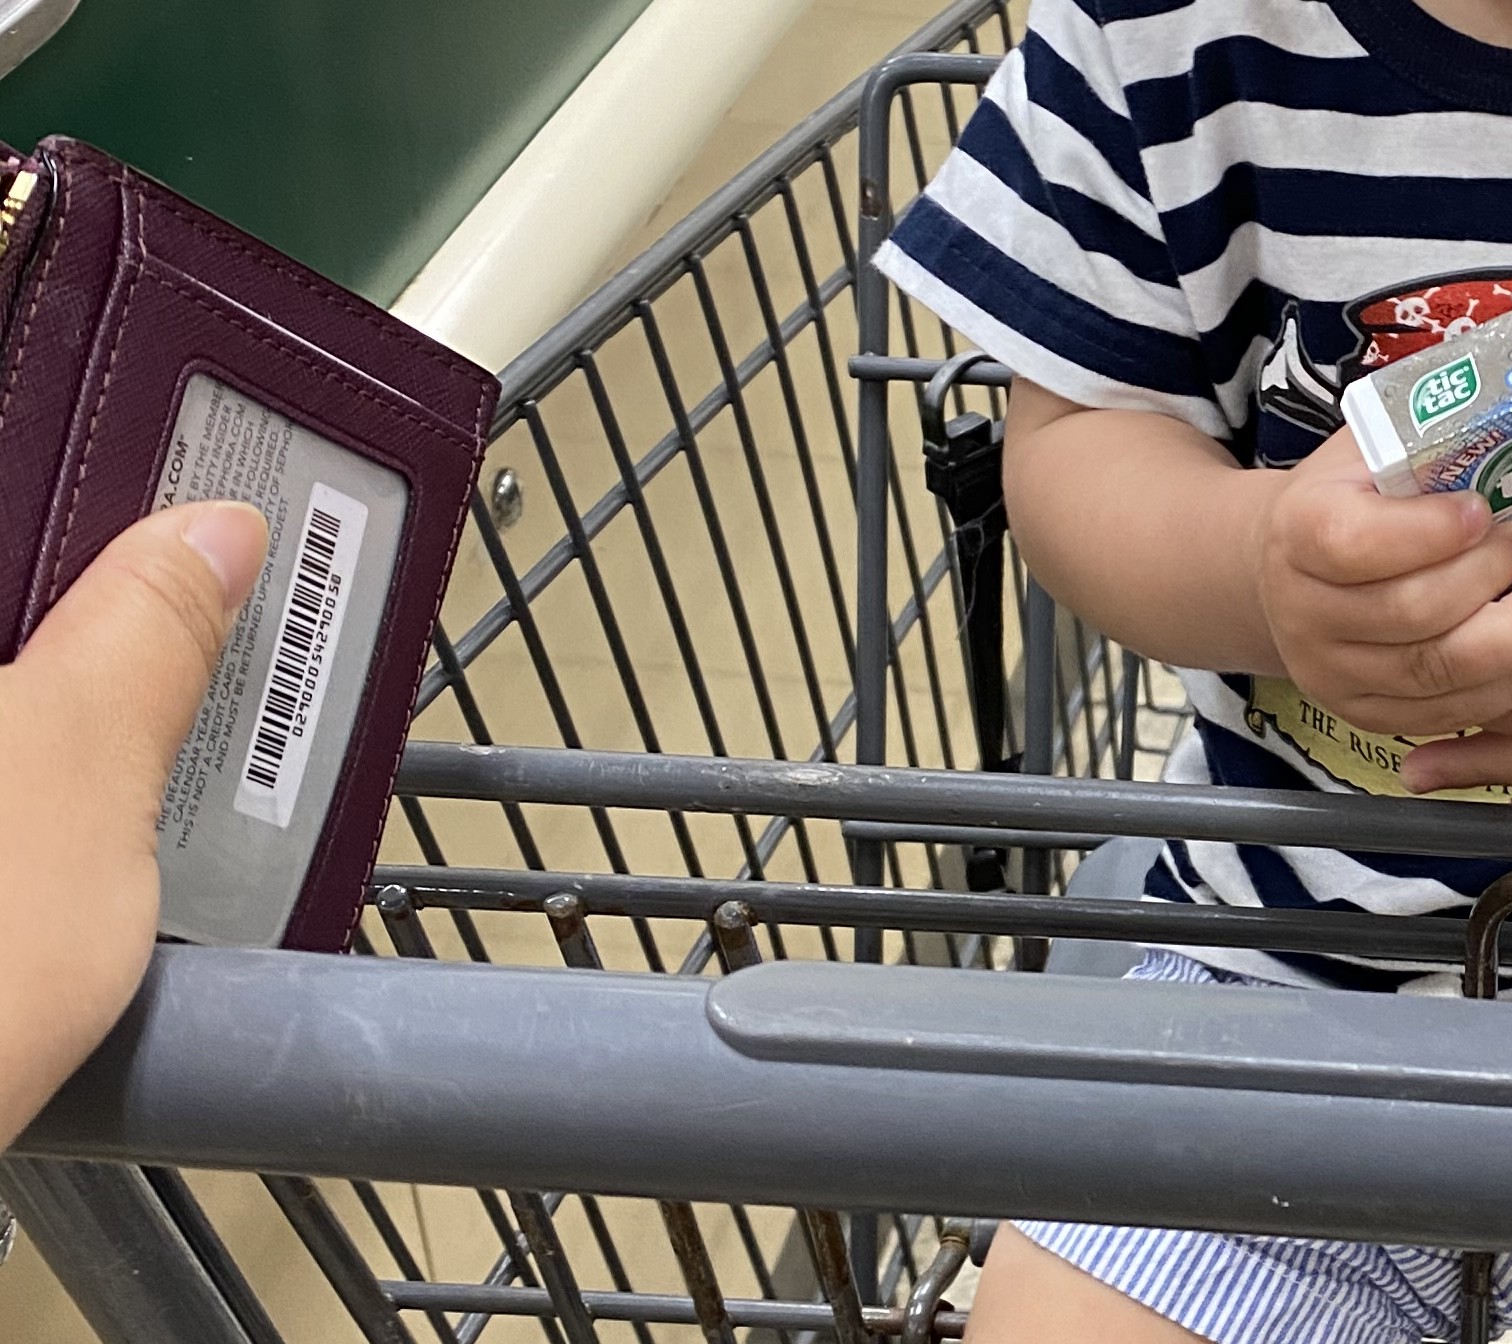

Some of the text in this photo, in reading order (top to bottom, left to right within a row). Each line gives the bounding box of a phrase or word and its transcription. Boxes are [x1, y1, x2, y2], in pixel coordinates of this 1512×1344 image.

[1423, 382, 1472, 414] tac
[1426, 368, 1468, 396] tic
[194, 440, 209, 470] THE
[201, 404, 232, 498] AUTY INSIDER
[1439, 428, 1508, 483] NEW!
[231, 469, 243, 486] IN
[269, 475, 281, 496] OF
[256, 560, 273, 601] UPON
[230, 625, 244, 655] THIS
[237, 603, 263, 677] RETURNED
[291, 573, 342, 737] 02900054290050
[233, 678, 245, 697] BE
[205, 702, 226, 752] CREDIT
[222, 698, 239, 738] MUST
[1299, 699, 1340, 744] THE
[201, 755, 211, 767] A
[213, 739, 228, 774] AND
[154, 746, 187, 832] THE BEAUTY
[171, 745, 201, 824] CALENDAR
[191, 768, 208, 800] NOT
[186, 803, 197, 817] IS
[177, 819, 193, 850] THIS
